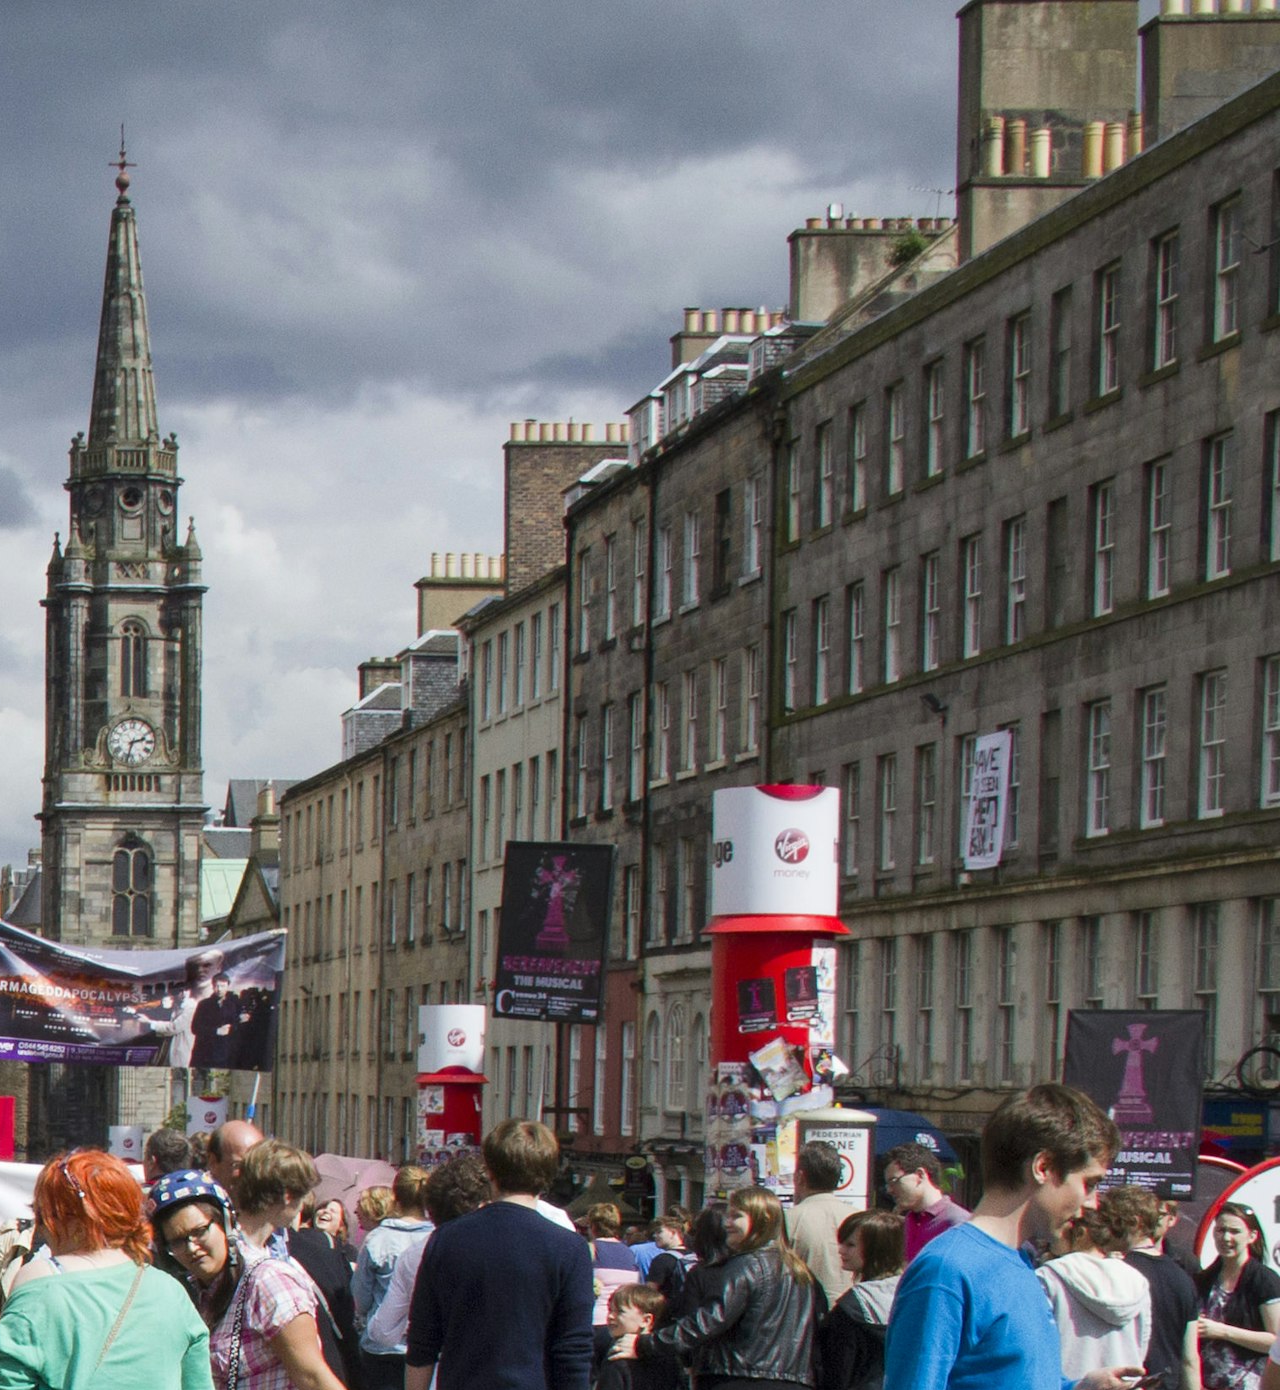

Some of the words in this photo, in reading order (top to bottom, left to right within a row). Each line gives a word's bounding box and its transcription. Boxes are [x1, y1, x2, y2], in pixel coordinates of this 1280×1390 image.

[777, 832, 809, 861] Virgin
[773, 869, 811, 879] money
[514, 975, 534, 986] THE
[535, 977, 583, 990] MUSICAL
[828, 1140, 854, 1150] ONE
